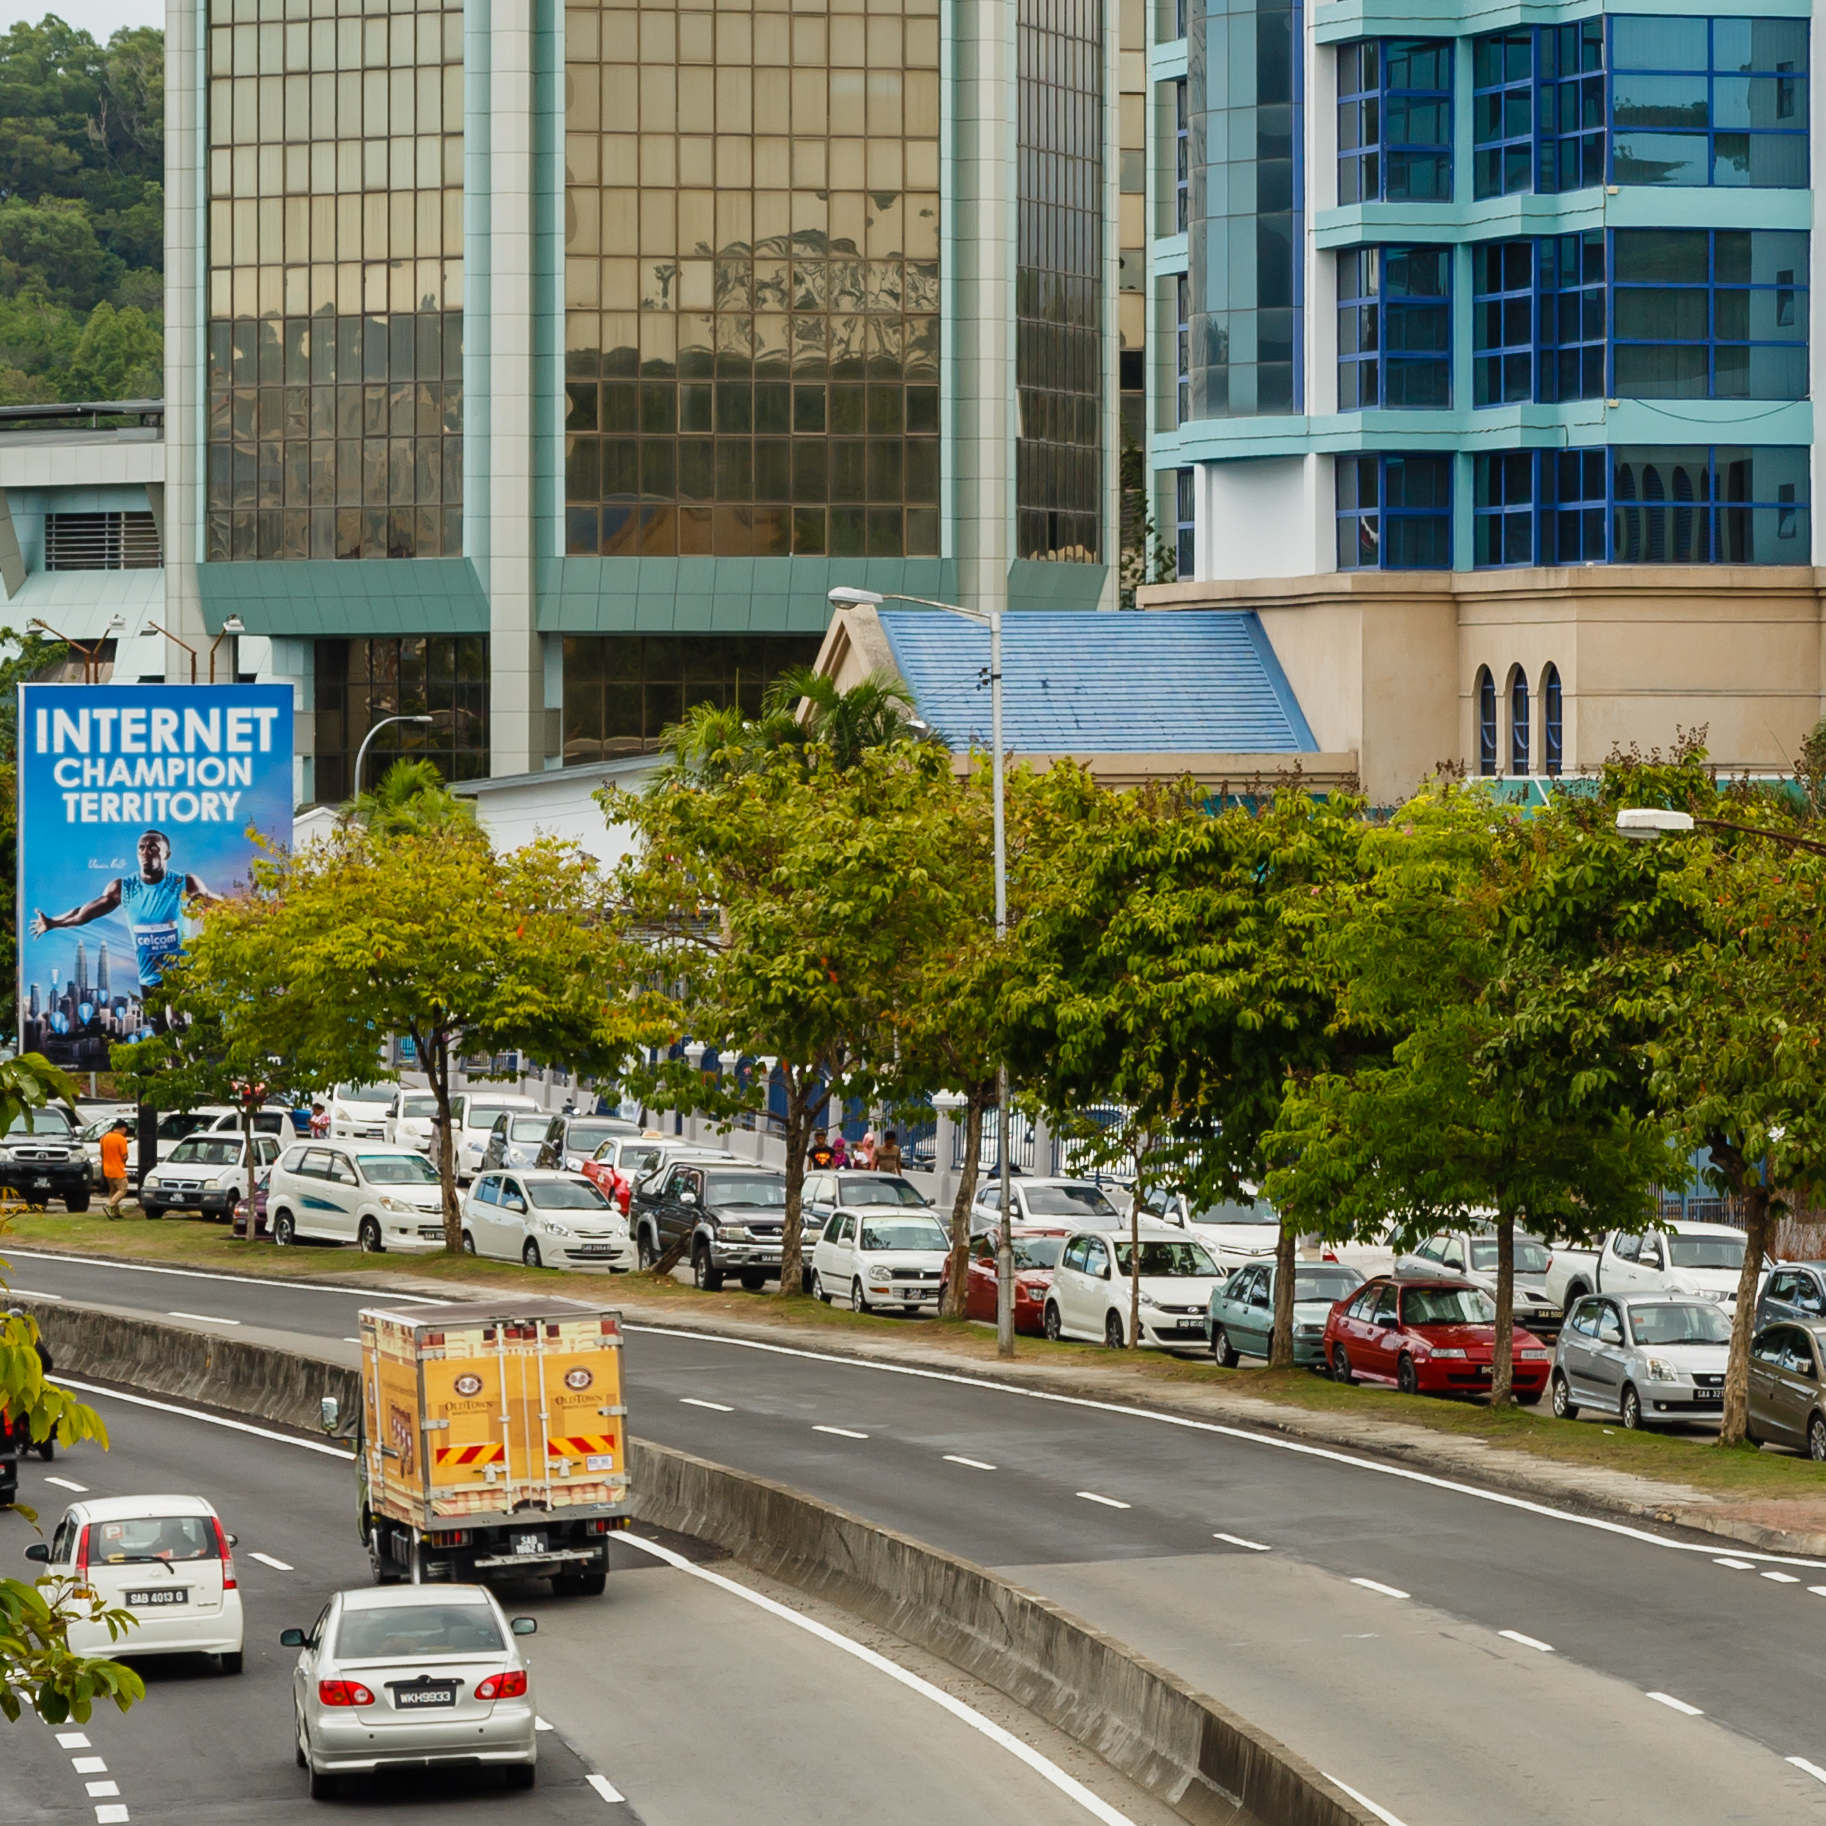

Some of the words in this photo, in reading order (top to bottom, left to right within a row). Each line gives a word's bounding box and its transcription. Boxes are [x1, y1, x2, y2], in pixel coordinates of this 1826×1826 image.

[36, 707, 279, 754] INTERNET
[53, 757, 252, 788] CHAMPION
[62, 791, 242, 823] TERRITORY
[130, 1593, 149, 1604] SAB
[151, 1592, 173, 1603] 4013
